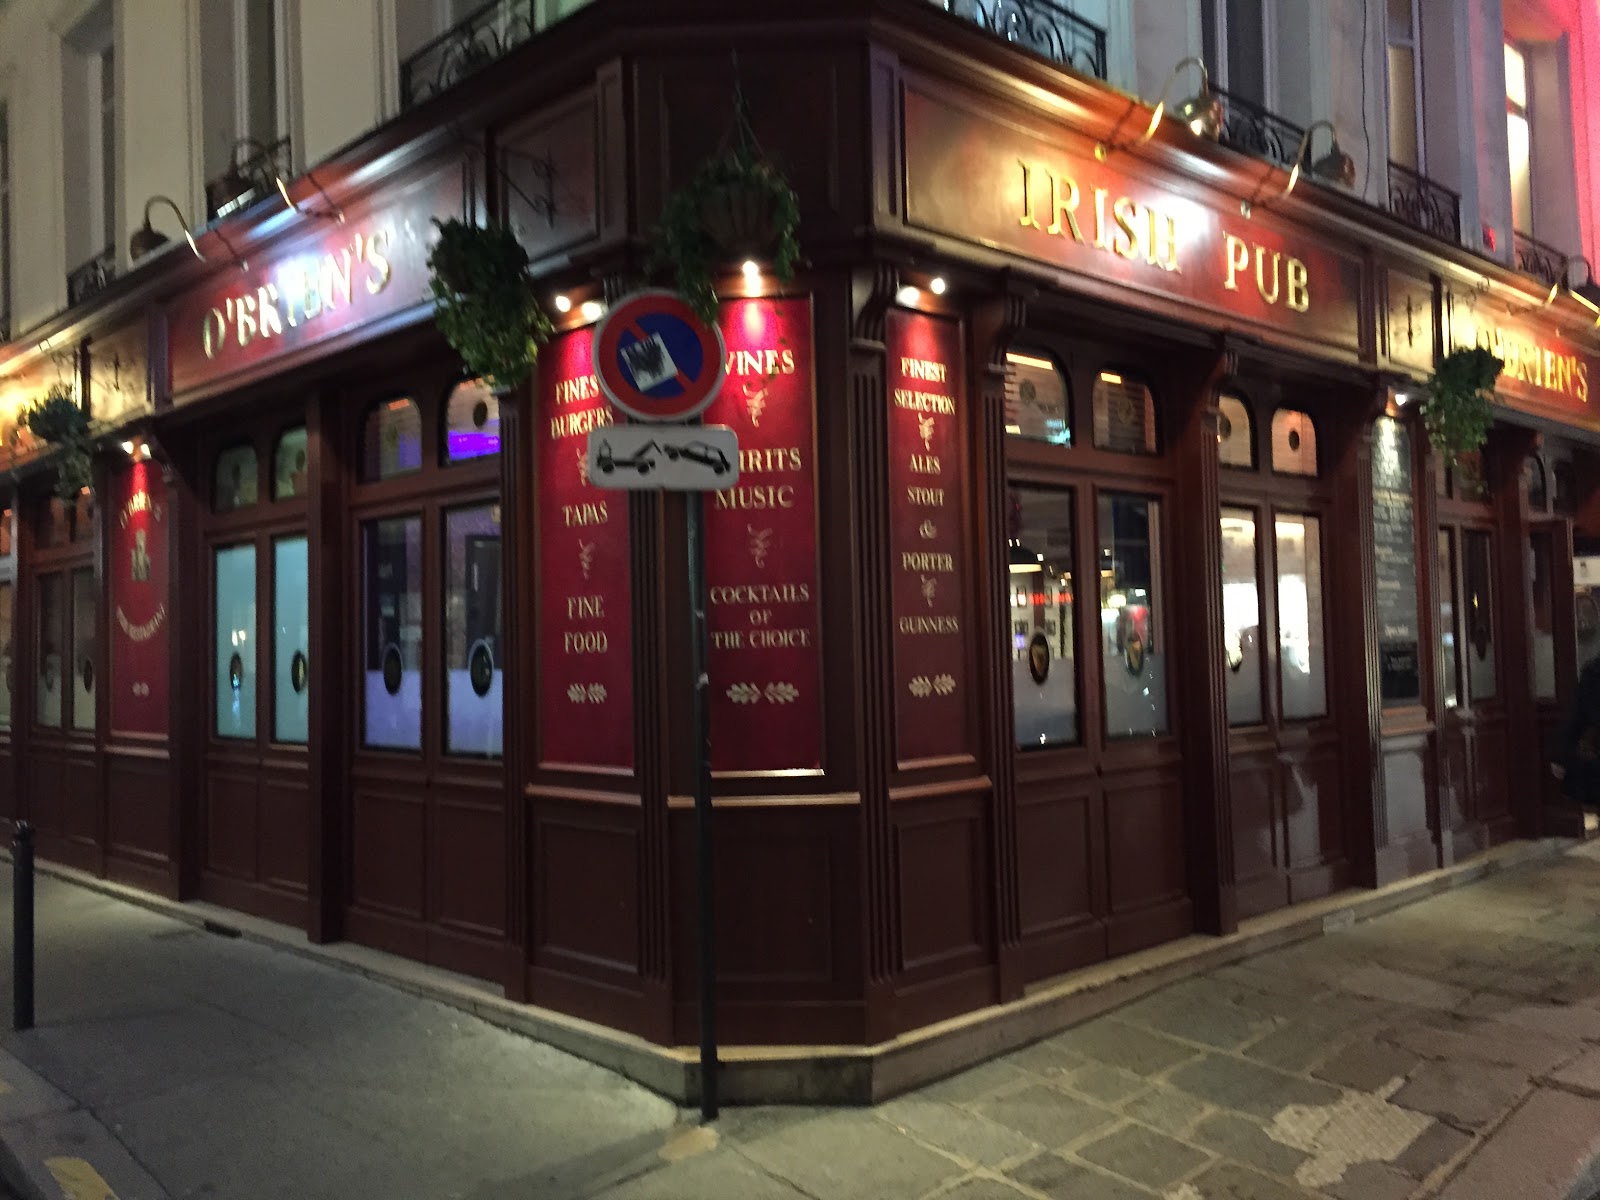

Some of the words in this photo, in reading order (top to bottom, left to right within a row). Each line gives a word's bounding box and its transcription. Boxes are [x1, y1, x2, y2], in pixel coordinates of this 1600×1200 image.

[1017, 158, 1182, 274] IRISH
[1222, 231, 1309, 313] PUB
[900, 357, 947, 383] FINEST
[555, 374, 599, 405] FINES
[894, 388, 956, 415] SELECTION
[550, 405, 614, 440] BURGERS
[739, 448, 802, 473] IRITS
[910, 454, 941, 475] ALES
[714, 484, 794, 510] MUSIC
[907, 485, 945, 507] STOUT
[562, 500, 608, 527] TAPAS
[919, 520, 937, 539] &
[902, 552, 953, 572] PORTER
[710, 583, 809, 604] COCKTAILS
[567, 595, 605, 619] FINE
[750, 609, 772, 625] OF
[900, 616, 959, 634] GUINNESS
[564, 631, 608, 654] FOOD
[711, 630, 745, 649] THE
[749, 628, 811, 648] CHOICE
